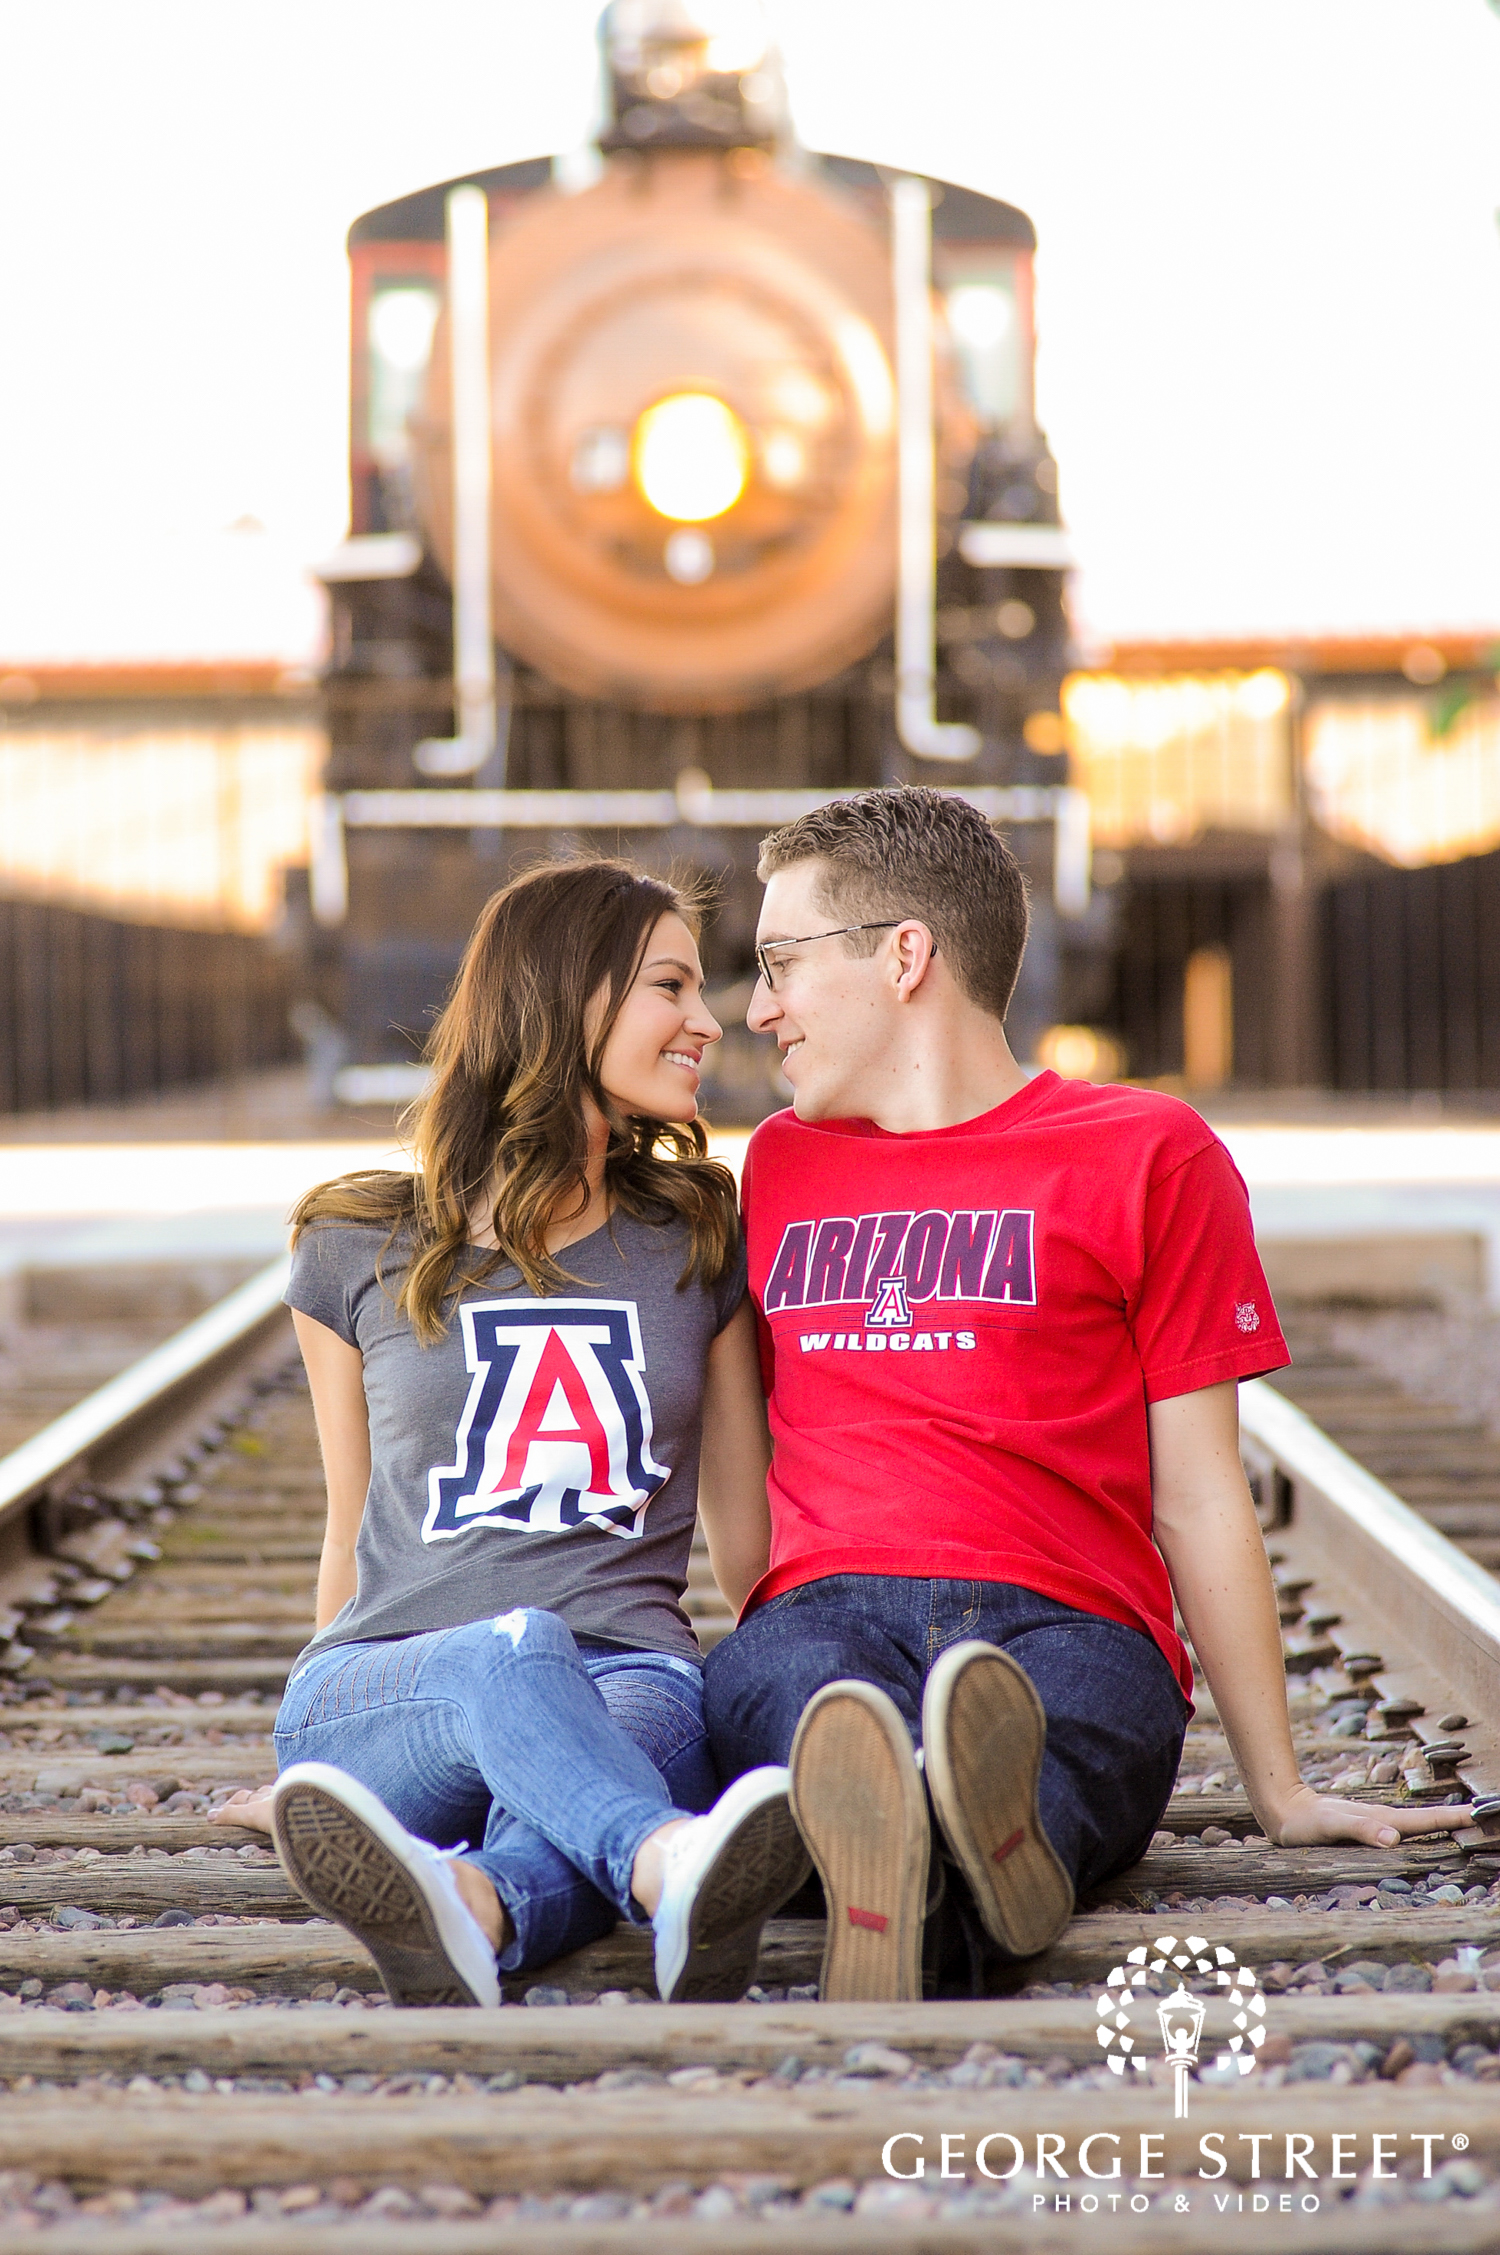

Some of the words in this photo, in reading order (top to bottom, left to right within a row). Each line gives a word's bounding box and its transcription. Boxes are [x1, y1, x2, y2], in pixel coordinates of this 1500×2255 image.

[764, 1209, 1037, 1315] ARIZONA
[864, 1276, 913, 1328] A
[799, 1331, 977, 1354] WILDCATS
[420, 1297, 672, 1545] A
